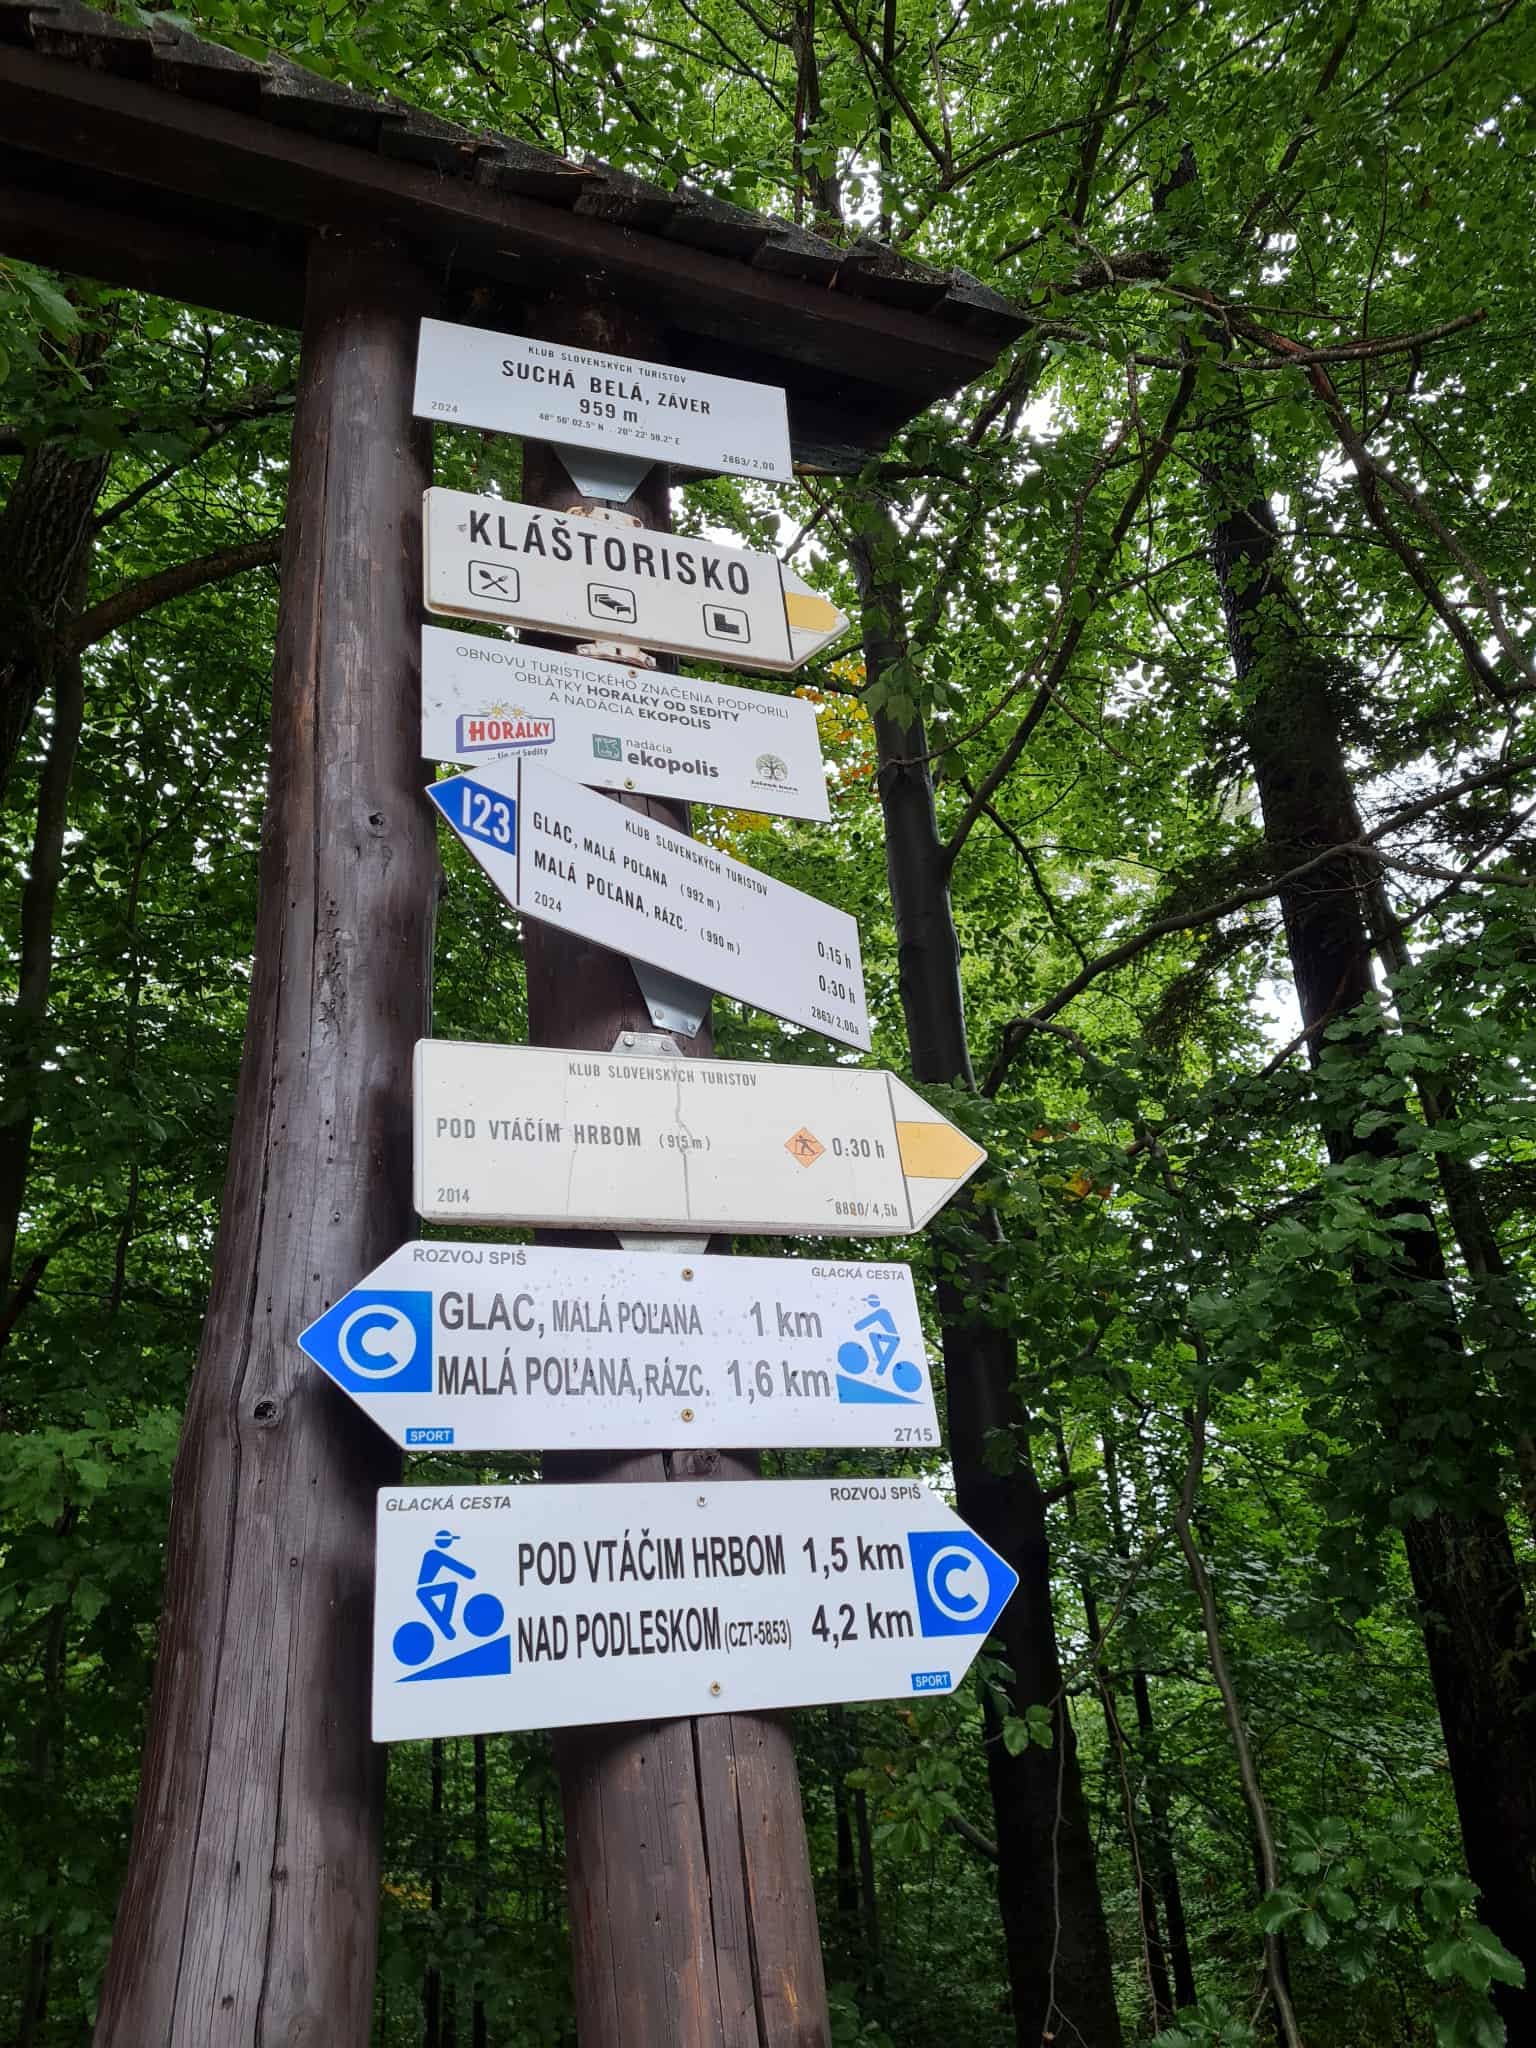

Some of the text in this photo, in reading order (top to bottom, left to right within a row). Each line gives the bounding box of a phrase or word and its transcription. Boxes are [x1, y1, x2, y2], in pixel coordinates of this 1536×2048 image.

[528, 346, 555, 358] KLUB
[639, 367, 686, 384] TURISTOV
[502, 360, 711, 415] SUCHÁ BELÁ, ZÁVER
[431, 400, 459, 413] 2024
[579, 398, 638, 424] 959 m
[469, 509, 750, 596] KLÁŠTORISKO
[456, 646, 789, 719] OBNOVU TURISTICKÉHO ZNAČENIA PODPORILI
[514, 671, 740, 722] OBLÁTKY HORALKY OD SEDITY
[549, 692, 712, 730] A NADÁCIA EKOPOLIS
[469, 719, 550, 742] HORALKY
[625, 738, 673, 754] nadácia
[627, 749, 719, 778] ekopolis
[462, 786, 511, 845] 123
[533, 811, 578, 849] GLAC,
[583, 837, 617, 864] MALÁ
[625, 819, 768, 897] KLUB SLOVENSKÝCH TURISTOV
[534, 849, 577, 884] MALÁ
[654, 905, 688, 932] RÁZC.
[534, 890, 563, 913] 2024
[817, 941, 852, 969] 0:15 h
[818, 975, 856, 1005] 0:30 h
[568, 1062, 601, 1077] KLUB
[701, 1071, 757, 1087] TURISTOV
[436, 1117, 476, 1139] POD
[488, 1116, 561, 1143] VTÁČÍM
[573, 1123, 641, 1147] HRBOM
[832, 1137, 885, 1159] 0:30 h
[437, 1187, 470, 1203] 2014
[413, 1248, 527, 1266] ROZVOJ SPIŠ
[811, 1265, 905, 1281] GLACKÁ CESTA
[439, 1291, 703, 1339] GLAC, MALÁ POĽANA
[750, 1301, 823, 1338] 1 km
[438, 1346, 518, 1396] MALÁ
[727, 1359, 830, 1404] 1,6 km
[410, 1430, 451, 1442] SPORT
[893, 1427, 933, 1442] 2715
[385, 1494, 512, 1511] GLACKÁ CESTA
[830, 1485, 921, 1501] ROZVOJ SPIŠ
[518, 1528, 786, 1586] POD VTÁČIM HRBOM
[802, 1535, 905, 1579] 1,5 km
[518, 1606, 792, 1663] NAD PODLESKOM (CZT-5853)
[811, 1602, 914, 1649] 4,2 km
[915, 1673, 949, 1688] SPORT
